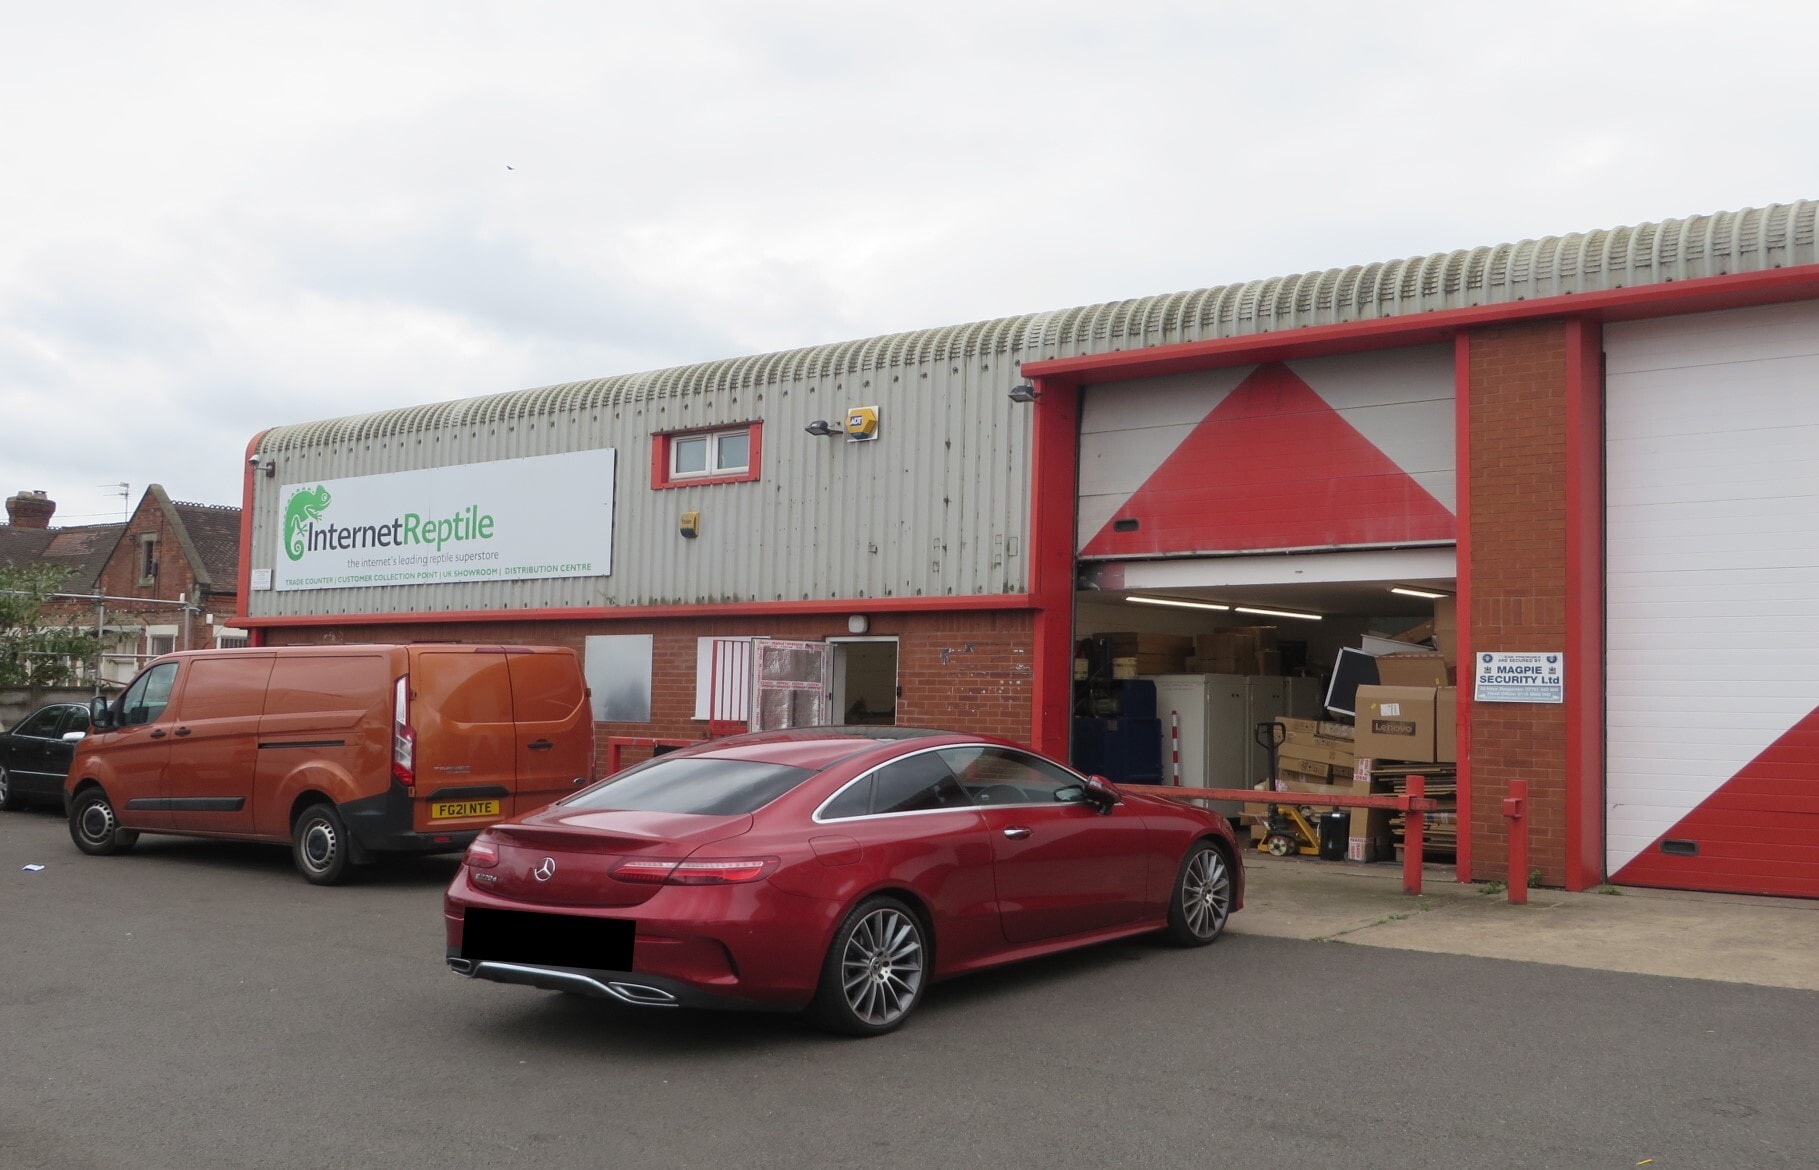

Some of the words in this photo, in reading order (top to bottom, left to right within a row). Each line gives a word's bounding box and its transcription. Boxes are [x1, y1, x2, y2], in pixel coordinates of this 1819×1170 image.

[849, 416, 863, 426] ADT
[307, 505, 494, 552] InternetReptile
[347, 557, 360, 568] the
[361, 555, 397, 568] internet's
[398, 554, 428, 567] leading
[429, 552, 454, 565] reptile
[455, 551, 499, 564] superstore
[305, 577, 334, 585] COUNTER
[337, 574, 372, 583] CUSTOMER
[373, 572, 415, 582] COLLECTION
[416, 571, 438, 580] POINT
[442, 570, 452, 578] UK
[453, 567, 498, 577] SHOWROOM
[504, 565, 559, 575] DISTRIBUTION
[560, 563, 592, 572] CENTRE
[1497, 666, 1543, 674] MAGPIE
[1479, 675, 1538, 684] SECURITY
[1541, 676, 1560, 684] Ltd
[1375, 722, 1413, 733] Lenovo
[439, 804, 467, 816] FG21
[470, 802, 492, 814] NTE
